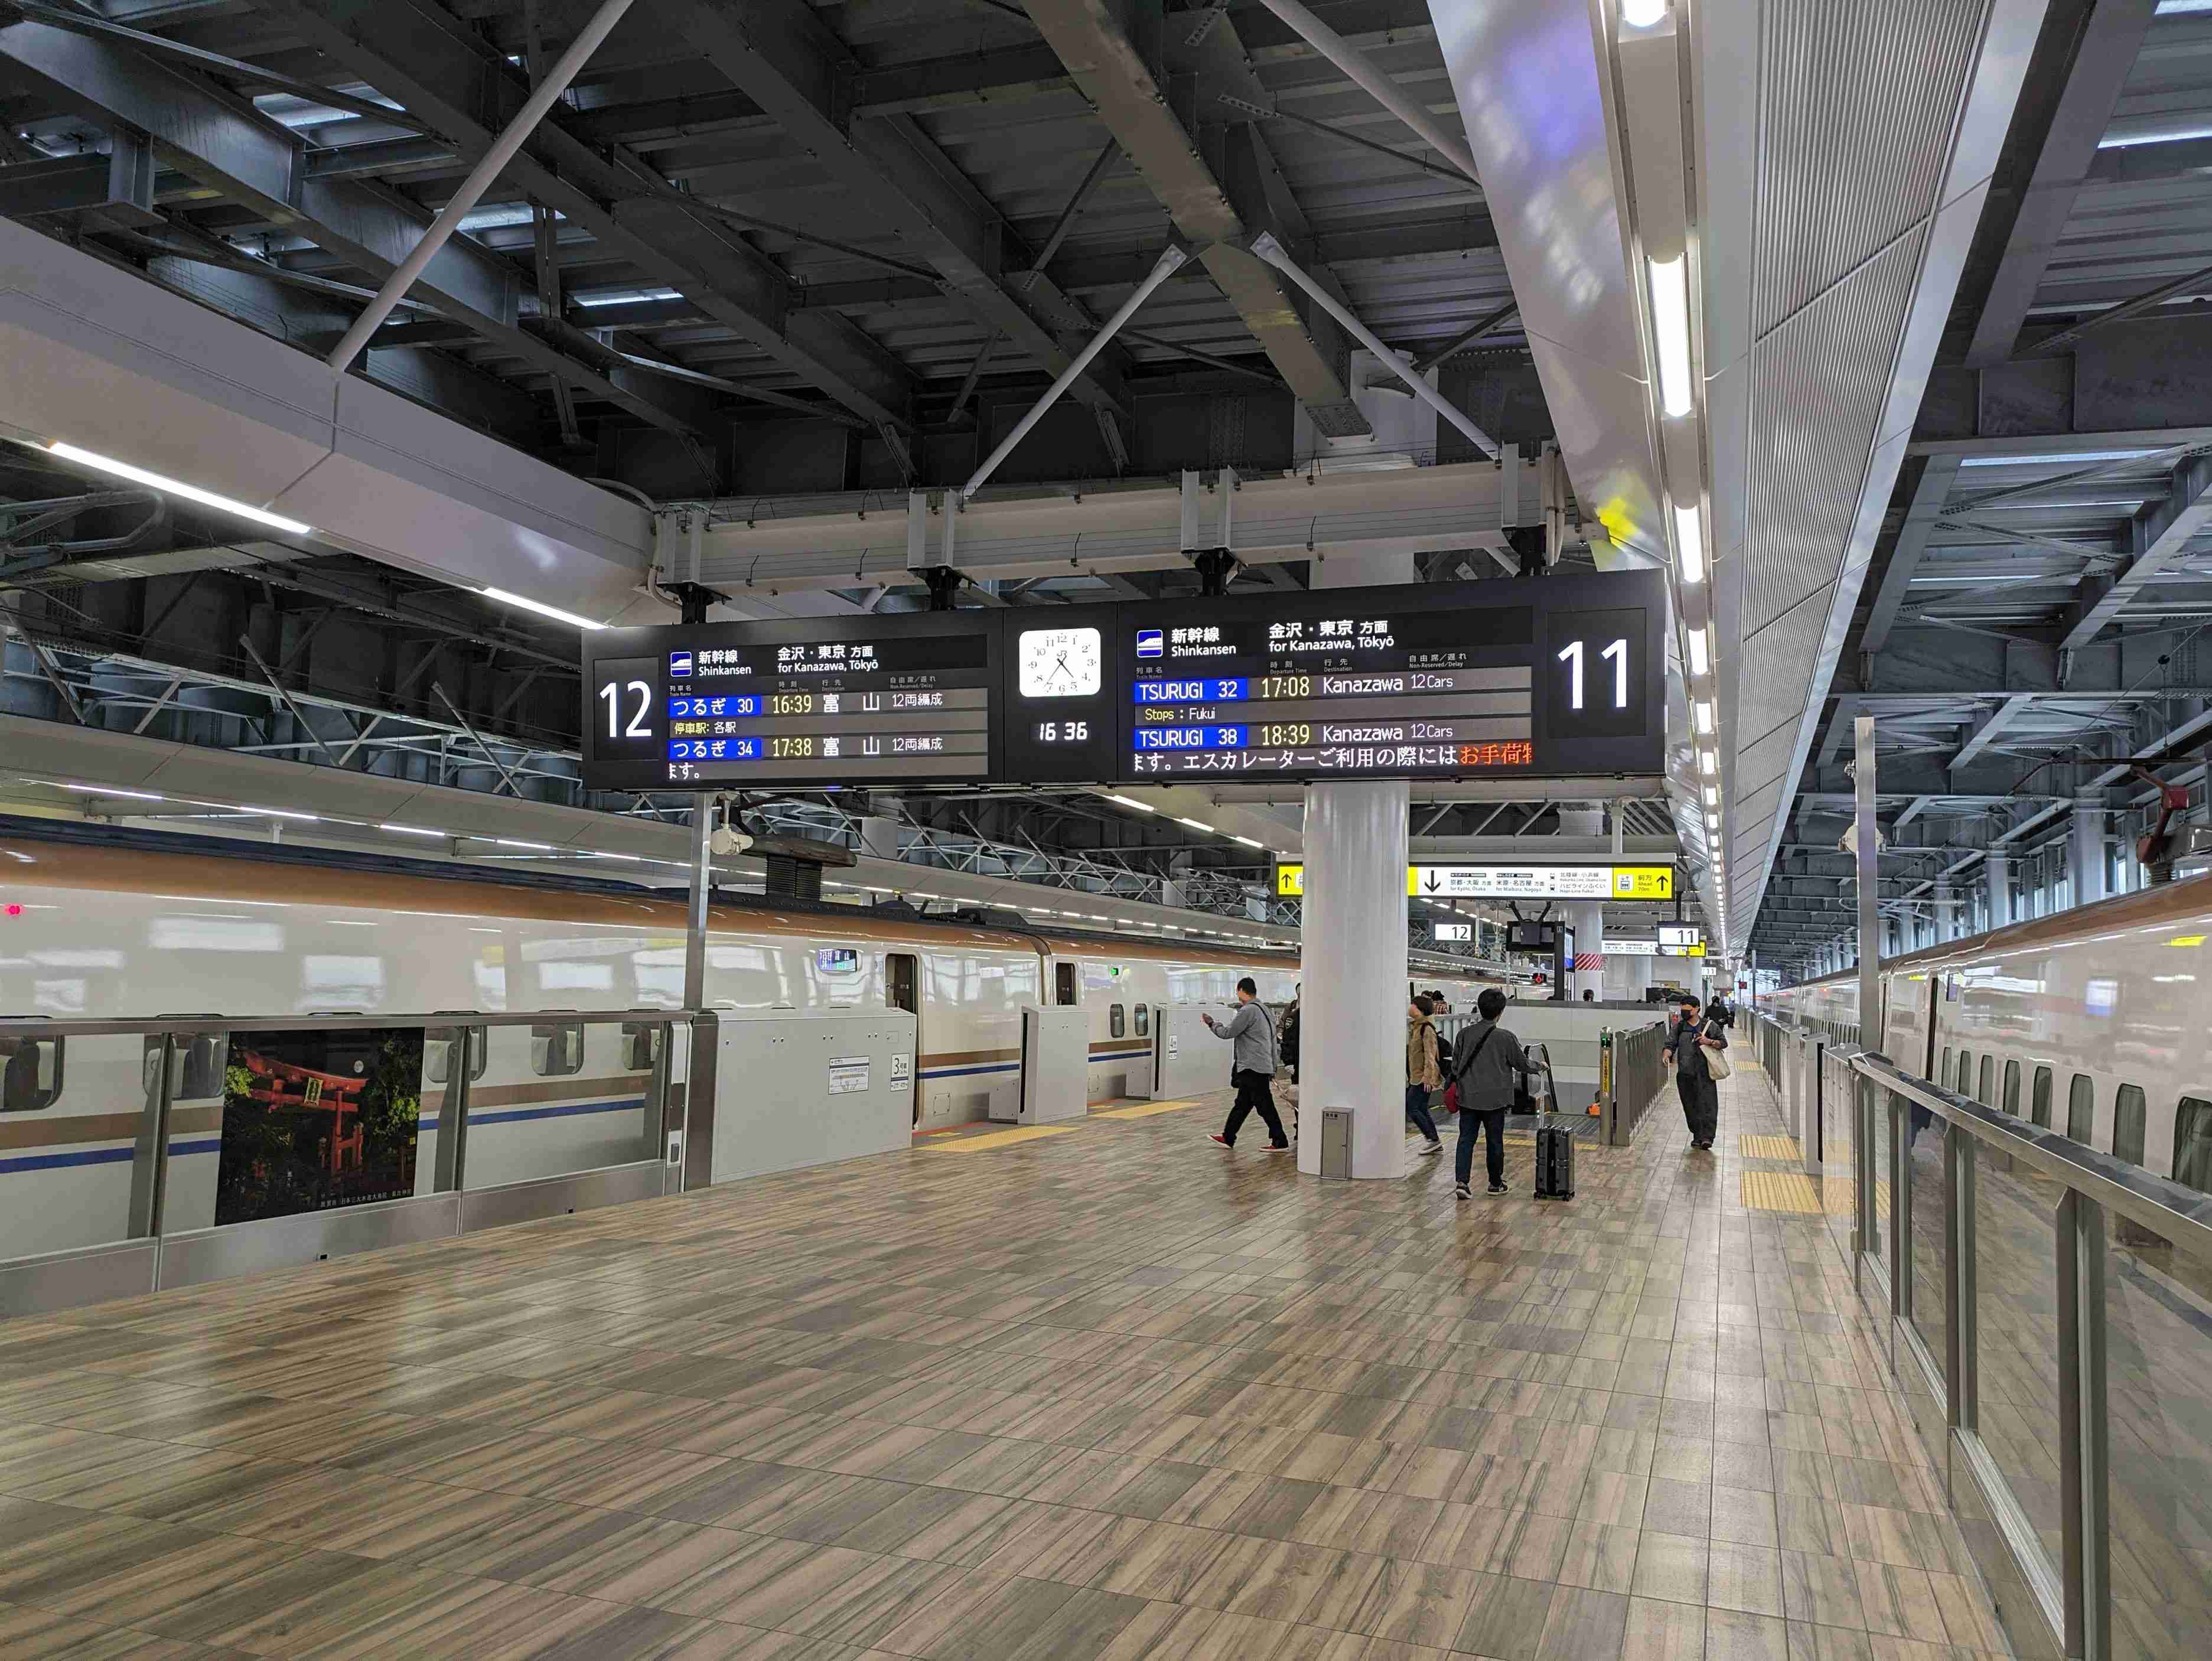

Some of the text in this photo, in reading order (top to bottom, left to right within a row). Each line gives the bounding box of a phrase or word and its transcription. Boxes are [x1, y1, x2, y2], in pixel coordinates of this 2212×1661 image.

[1360, 621, 1388, 634] 方面
[1171, 627, 1220, 643] 新幹線
[1171, 644, 1236, 657] Shinkansen
[1269, 636, 1395, 652] for Kanazawa, Tōkyō
[698, 650, 738, 665] 新幹線
[851, 646, 873, 657] 方面
[699, 665, 751, 676] Shinkansen
[777, 659, 878, 673] for Kanazawa, Tōkyō
[1081, 672, 1088, 680] 4
[1558, 639, 1628, 709] 11
[1047, 682, 1053, 691] 7
[1059, 685, 1066, 693] 6
[1139, 682, 1203, 700] TSURUGI
[1218, 680, 1237, 698] 32
[1262, 676, 1310, 698] 17:08
[1323, 676, 1403, 694] Kanazawa
[600, 681, 652, 738] 12
[673, 698, 727, 715] つるぎ
[737, 698, 753, 713] 30
[773, 695, 812, 714] 16:39
[892, 693, 943, 708] 12両編成
[1145, 708, 1174, 721] Stops
[1189, 707, 1216, 719] Fukui
[714, 721, 737, 734] 各駅
[1139, 729, 1203, 747] TSURUGI
[1218, 728, 1237, 745] 38
[1262, 725, 1310, 746] 18:39
[1323, 725, 1403, 742] Kanazawa
[673, 740, 727, 757] つるぎ
[737, 741, 753, 755] 34
[773, 738, 812, 757] 17:38
[892, 737, 943, 751] 12両編成
[1451, 926, 1468, 939] 12
[1677, 930, 1694, 943] 11
[894, 1058, 900, 1074] 3
